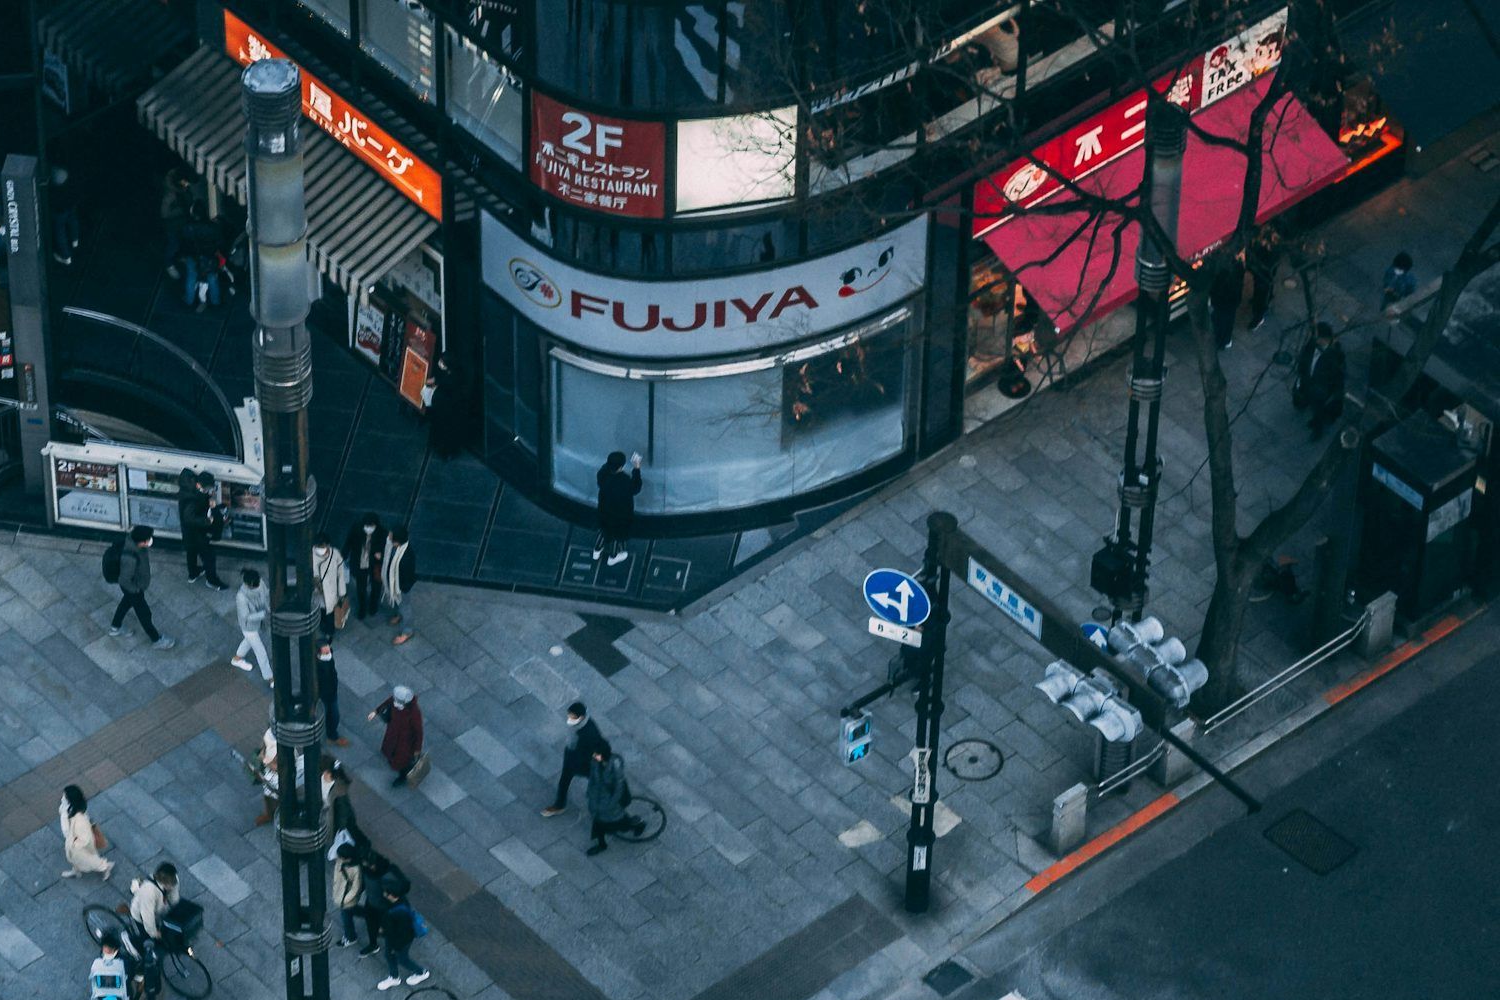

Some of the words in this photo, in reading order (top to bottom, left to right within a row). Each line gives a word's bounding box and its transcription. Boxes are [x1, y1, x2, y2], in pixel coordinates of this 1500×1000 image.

[1209, 59, 1238, 84] TAX
[561, 111, 624, 158] 2F
[574, 173, 658, 198] RESTAURANT
[570, 284, 820, 333] FUJIYA
